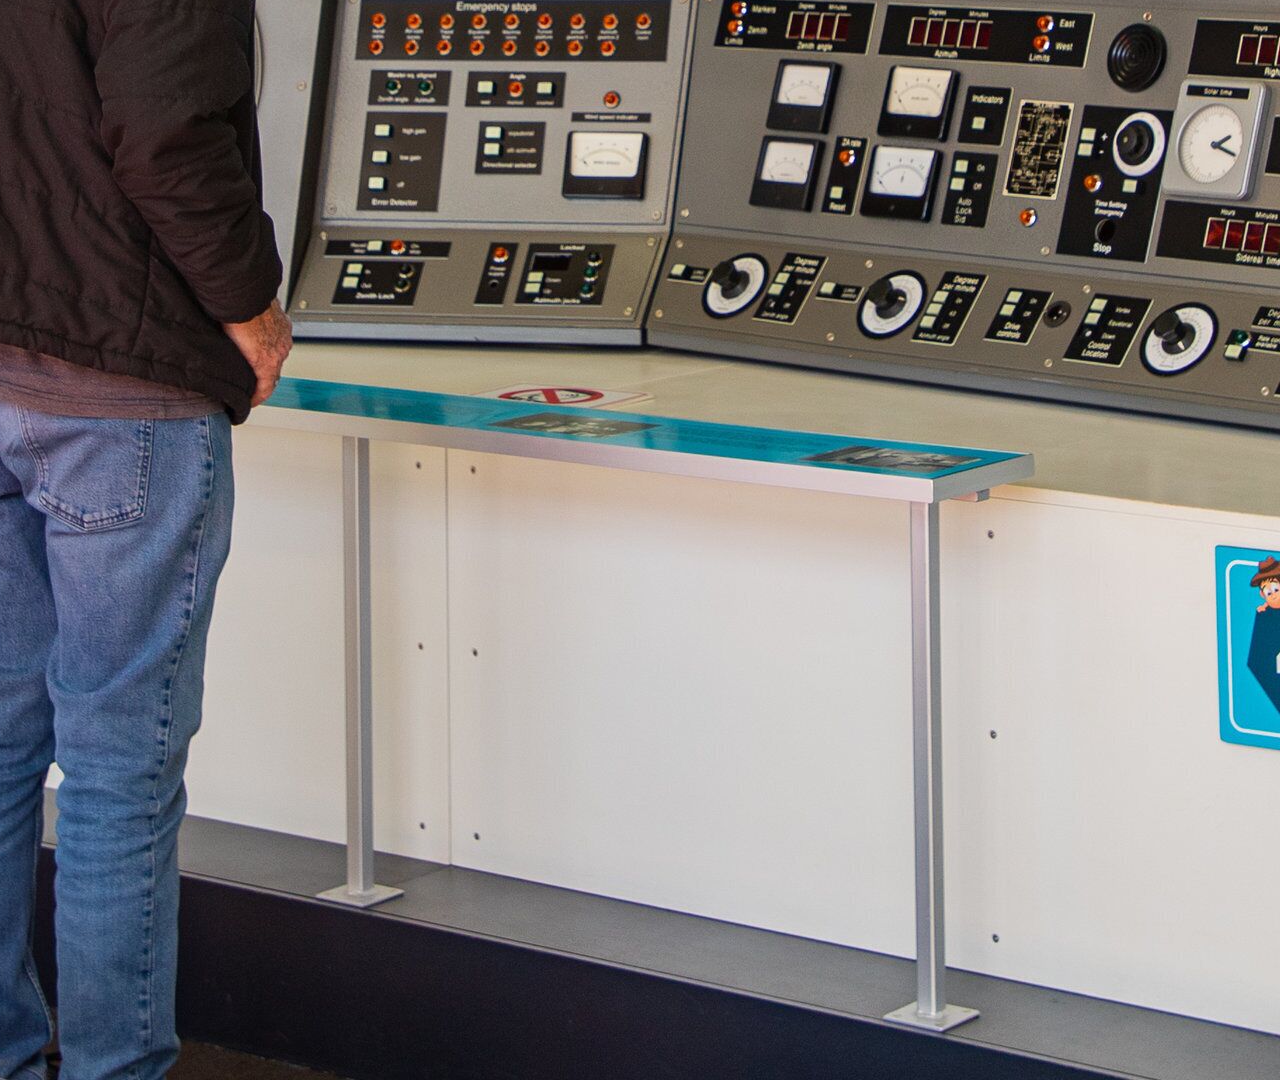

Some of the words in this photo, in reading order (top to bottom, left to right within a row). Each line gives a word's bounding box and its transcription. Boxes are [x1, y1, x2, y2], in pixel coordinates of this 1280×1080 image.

[456, 1, 509, 13] Emergency
[511, 2, 537, 13] stops
[972, 95, 1004, 104] Indicators
[1093, 243, 1112, 254] Stop
[1235, 252, 1262, 265] Sidereal
[1266, 255, 1280, 266] time
